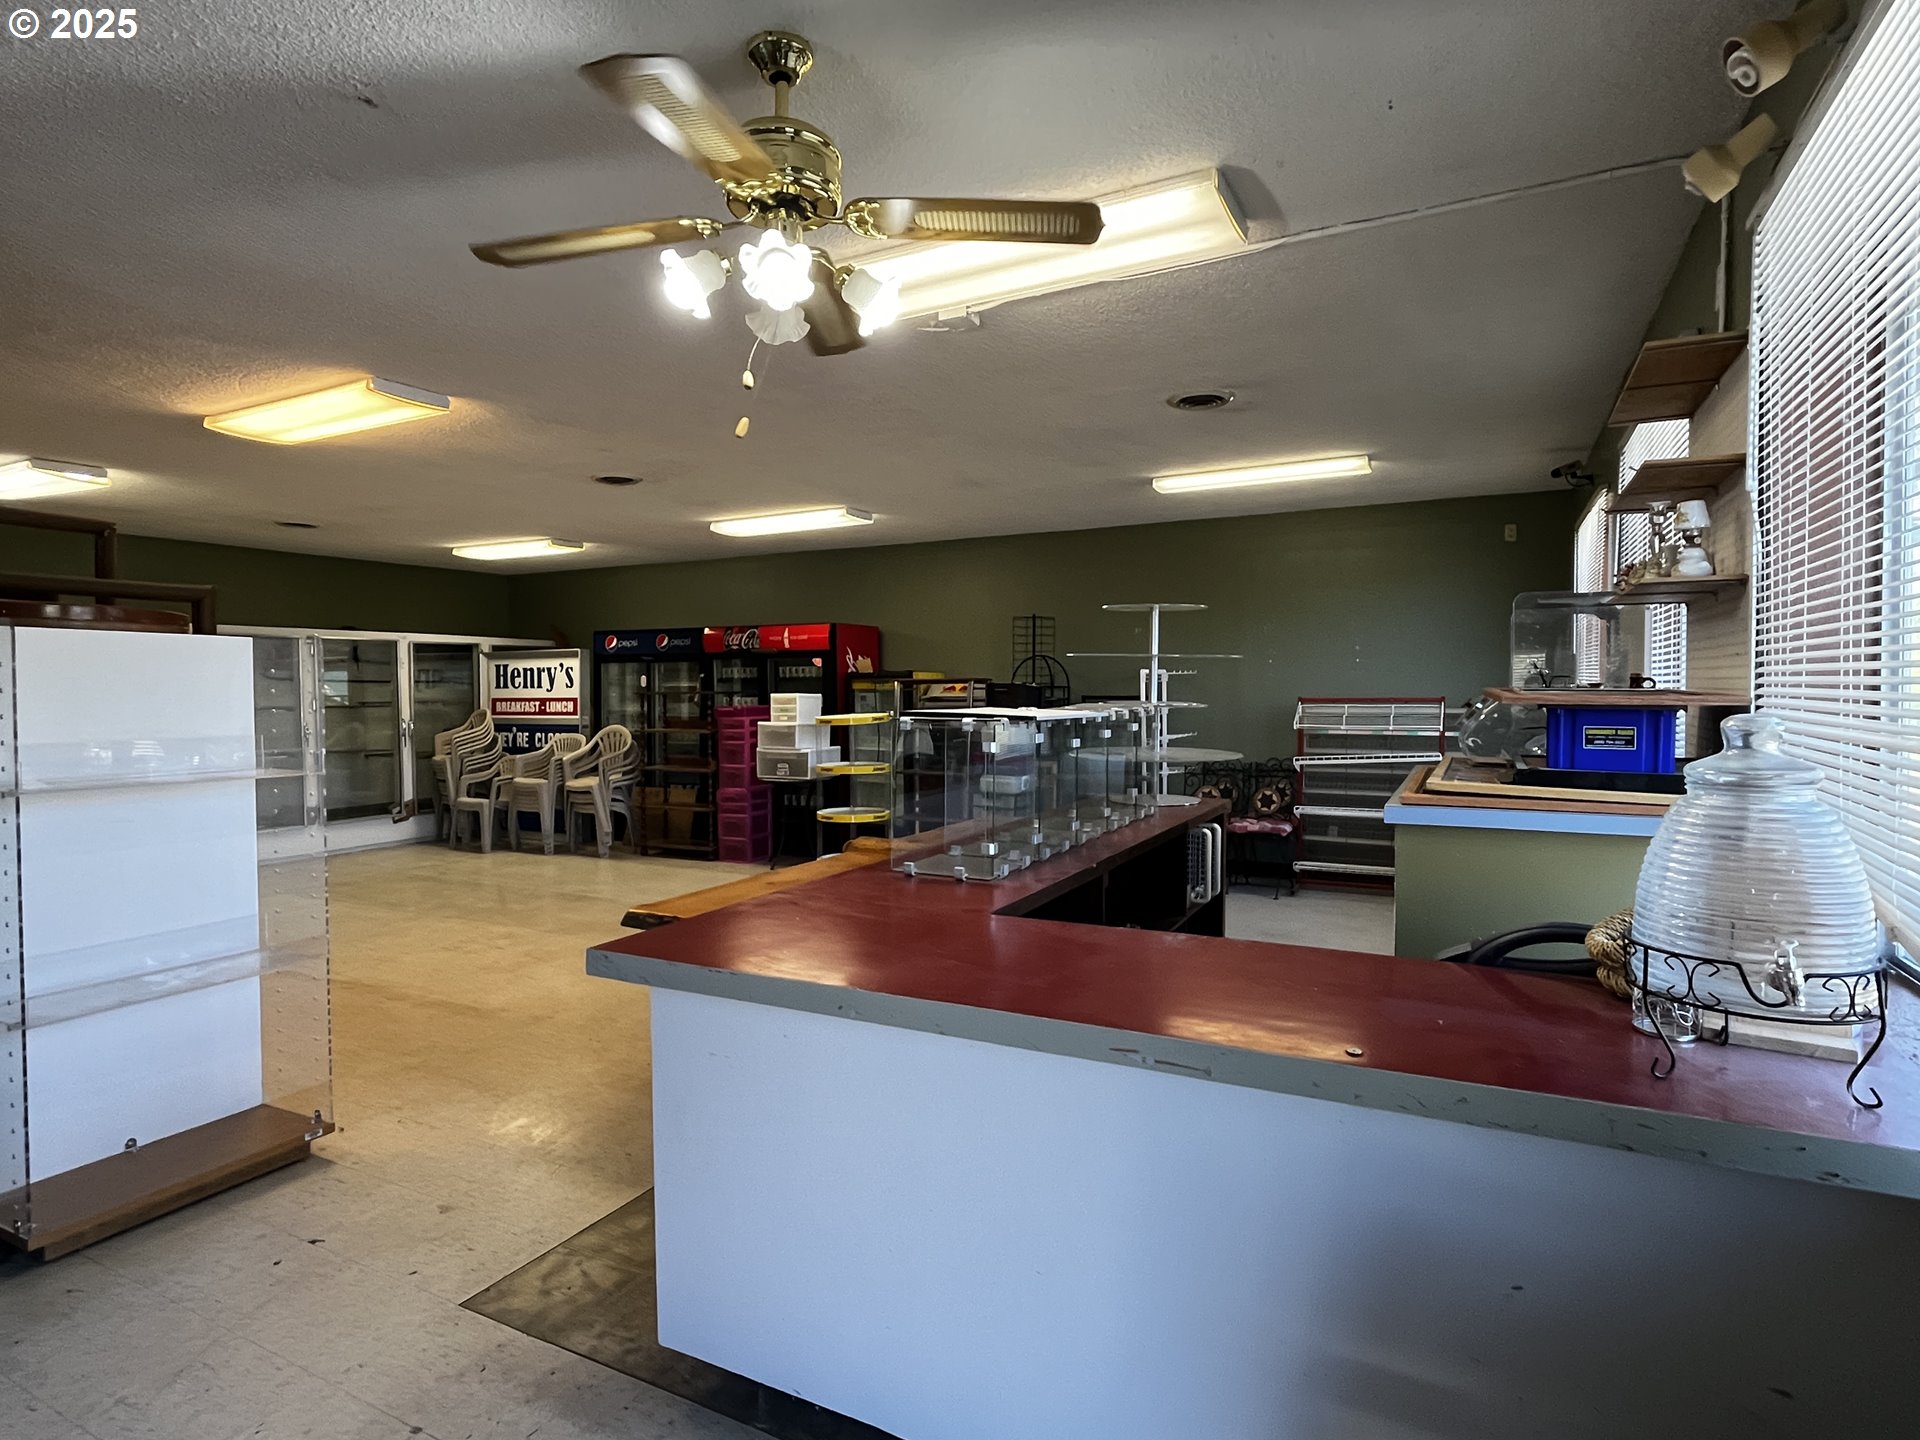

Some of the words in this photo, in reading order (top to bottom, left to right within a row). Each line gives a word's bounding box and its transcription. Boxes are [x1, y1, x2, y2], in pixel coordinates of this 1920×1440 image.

[618, 639, 638, 648] pepsi
[494, 662, 574, 692] Henry's
[495, 701, 540, 713] BREAKFAST
[546, 701, 574, 713] LUNCH
